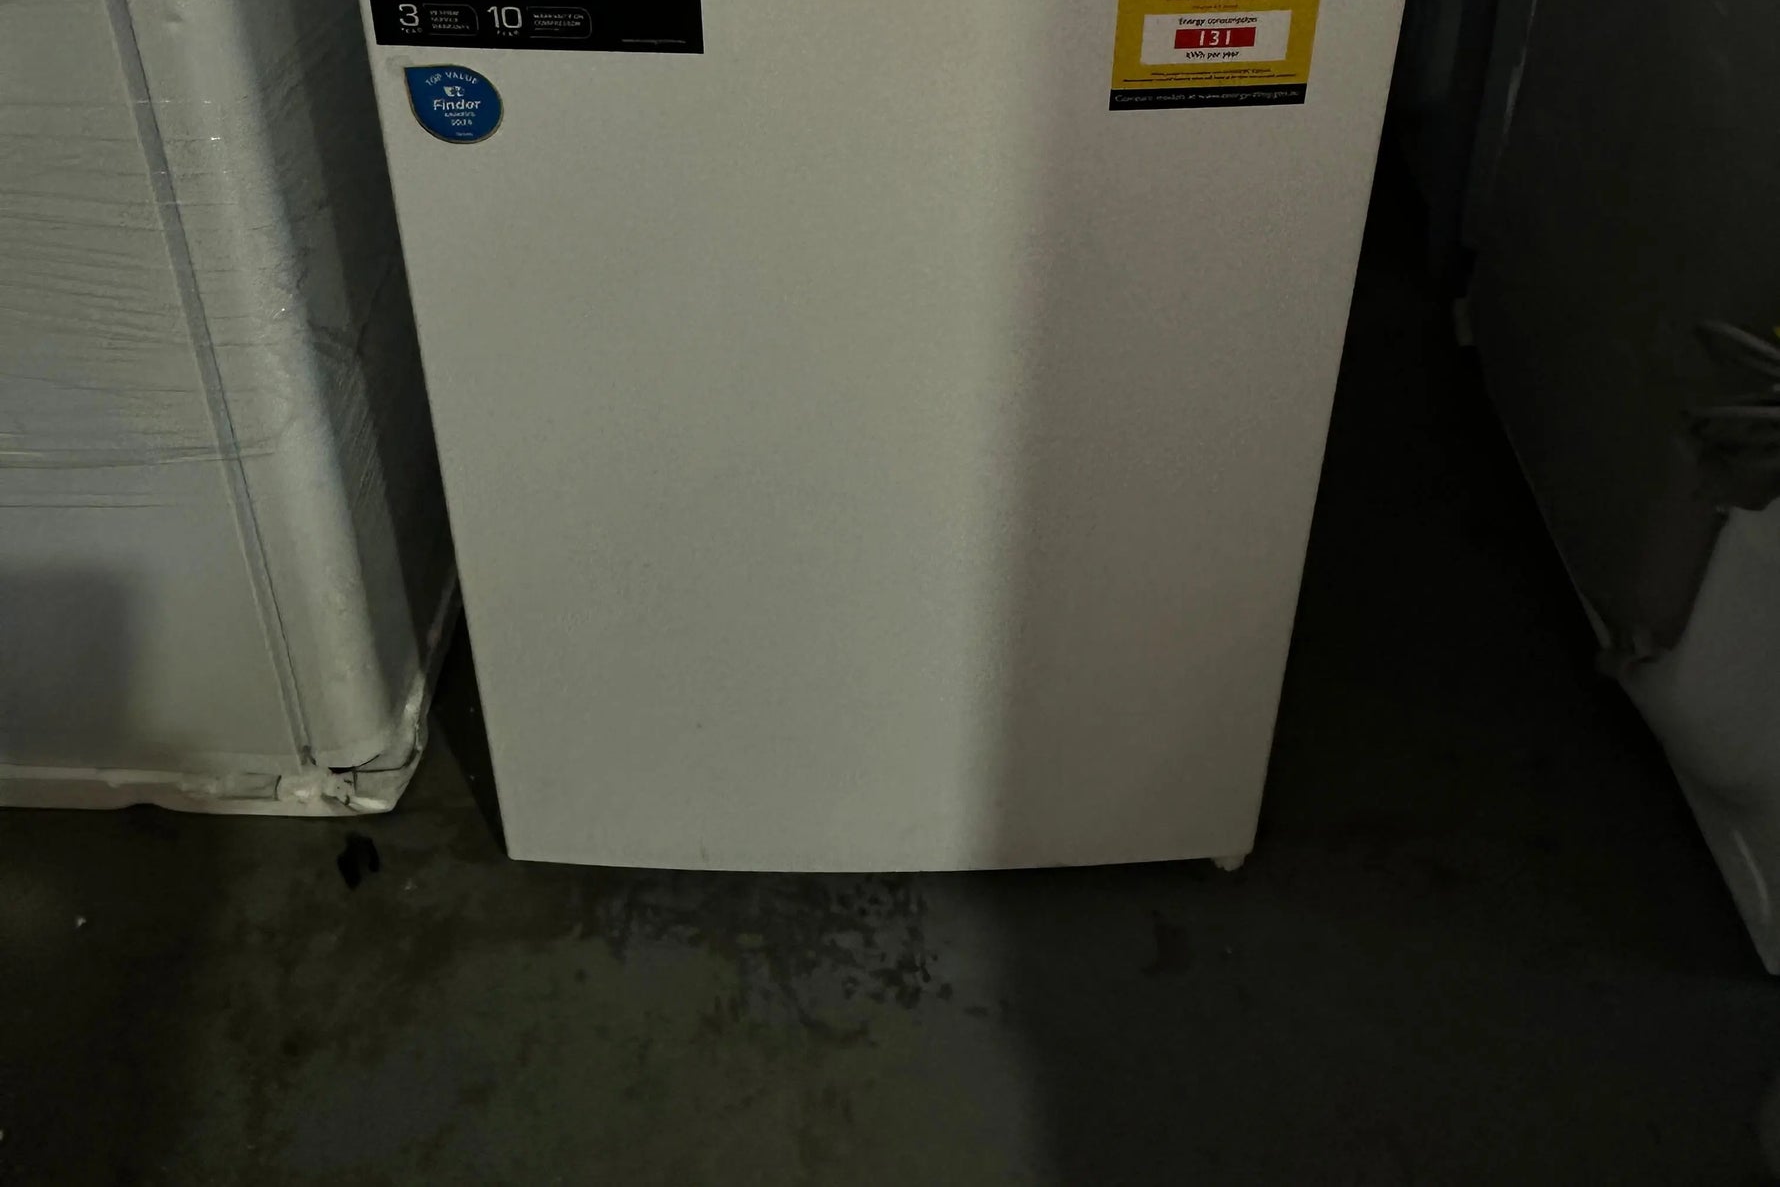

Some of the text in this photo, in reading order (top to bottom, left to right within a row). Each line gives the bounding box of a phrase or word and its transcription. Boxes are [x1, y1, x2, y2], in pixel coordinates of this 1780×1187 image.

[398, 3, 523, 29] 3 10
[1199, 29, 1231, 46] 131
[444, 71, 478, 85] VALUE
